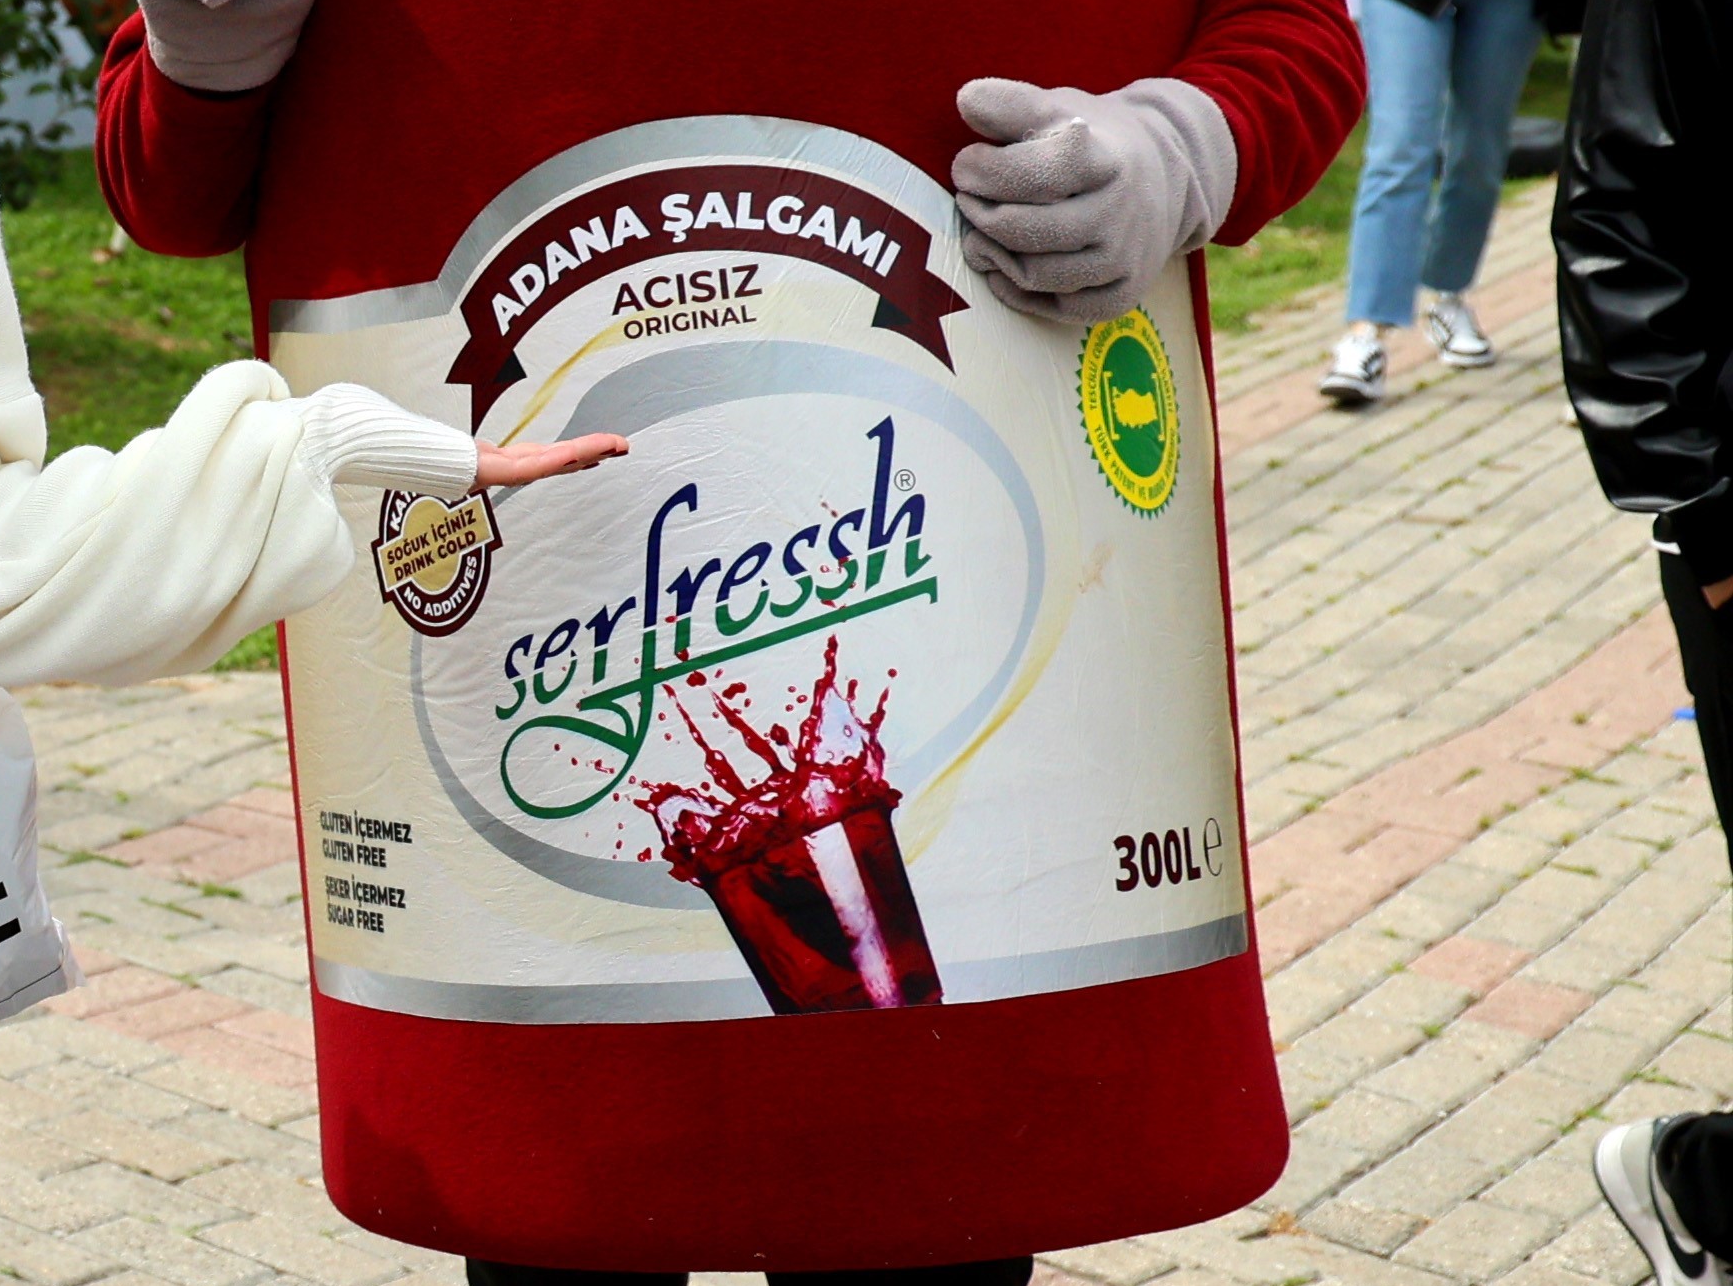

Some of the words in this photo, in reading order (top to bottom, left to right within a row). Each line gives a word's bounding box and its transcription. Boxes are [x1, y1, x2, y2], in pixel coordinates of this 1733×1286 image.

[490, 205, 651, 337] ADANA
[660, 191, 903, 278] ŞALGAMI
[611, 263, 764, 316] ACISIZ
[623, 304, 757, 340] ORIGINAL
[386, 532, 431, 565] SOĞUK
[430, 508, 477, 543] İÇİNİZ
[394, 550, 436, 582] DRINK
[437, 530, 477, 560] COLD
[403, 586, 422, 610] NO
[424, 556, 478, 617] ADDITIVES
[495, 414, 939, 820] serfressh
[319, 810, 353, 835] GLUTEN
[353, 809, 413, 844] İÇERMEZ
[322, 838, 355, 863] GLUTEN
[356, 844, 387, 868] FREE
[1113, 826, 1202, 892] 300L
[351, 873, 407, 909] İÇERMEZ
[327, 903, 355, 928] SUGAR
[356, 909, 385, 933] FREE
